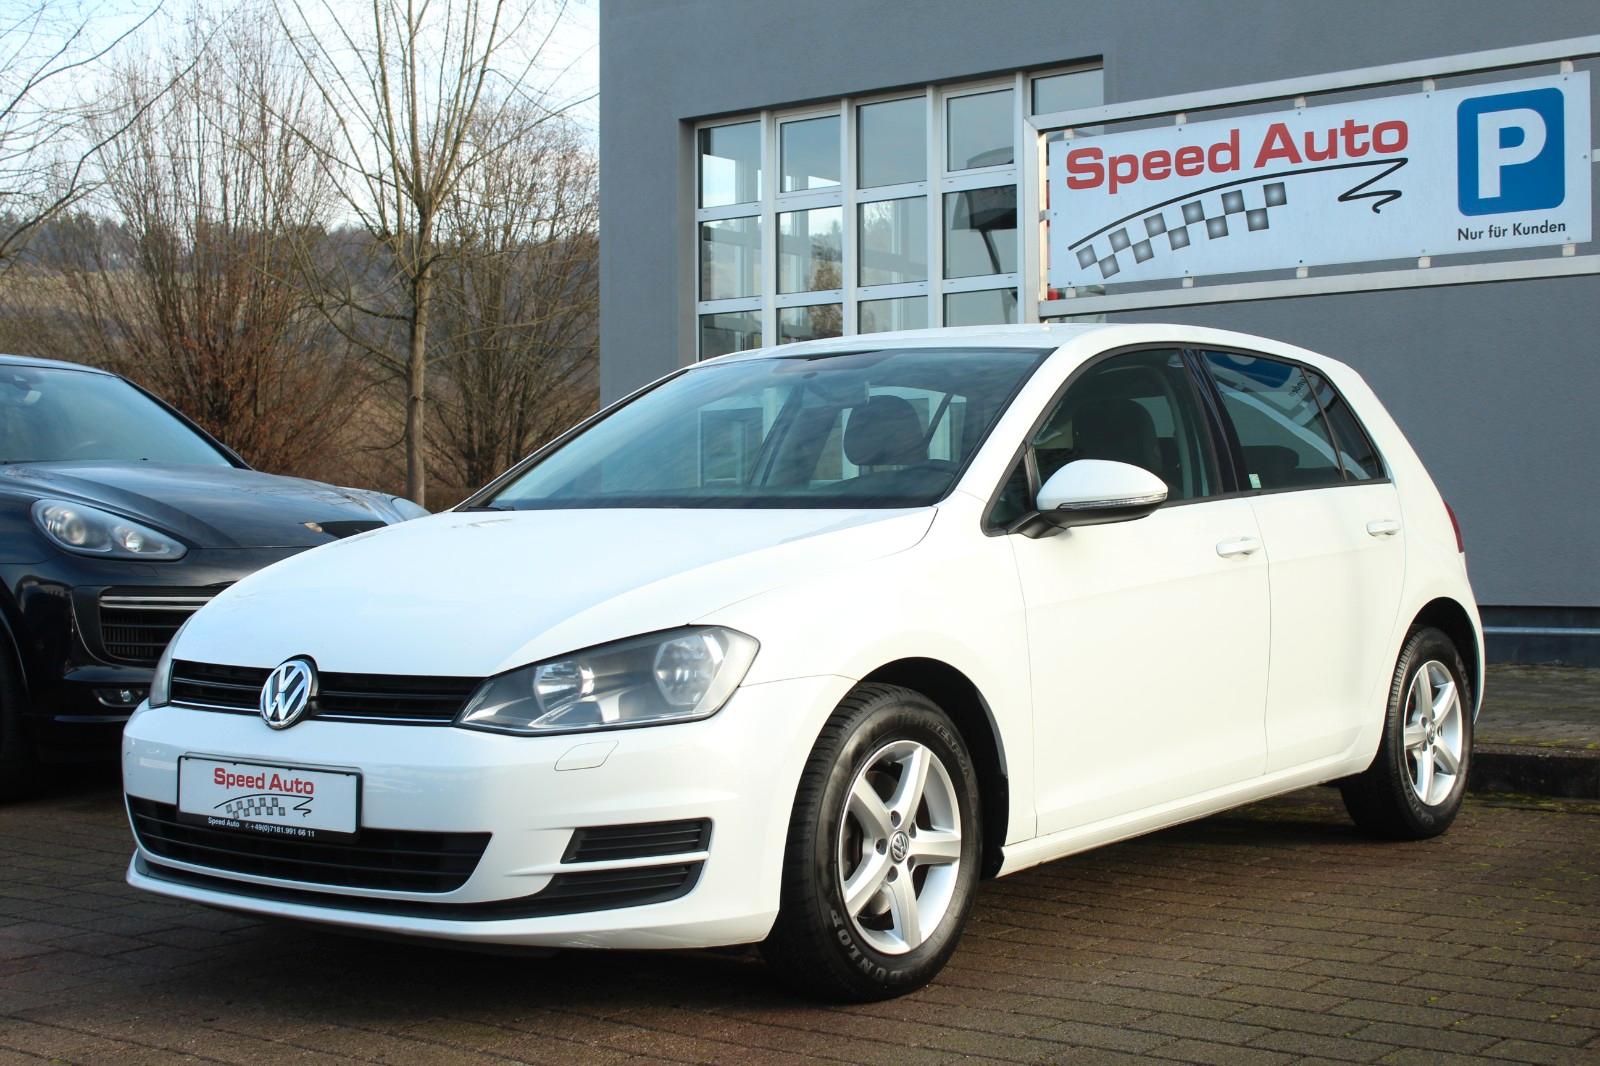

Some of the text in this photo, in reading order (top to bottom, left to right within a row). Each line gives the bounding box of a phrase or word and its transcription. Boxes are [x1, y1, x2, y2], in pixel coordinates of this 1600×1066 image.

[1066, 119, 1409, 195] Speed Auto
[1477, 108, 1547, 199] P
[1457, 219, 1566, 241] Nur für Kunden
[214, 767, 314, 795] Speed Auto
[207, 816, 226, 826] Speed
[226, 819, 240, 828] Auto
[307, 830, 315, 838] 11
